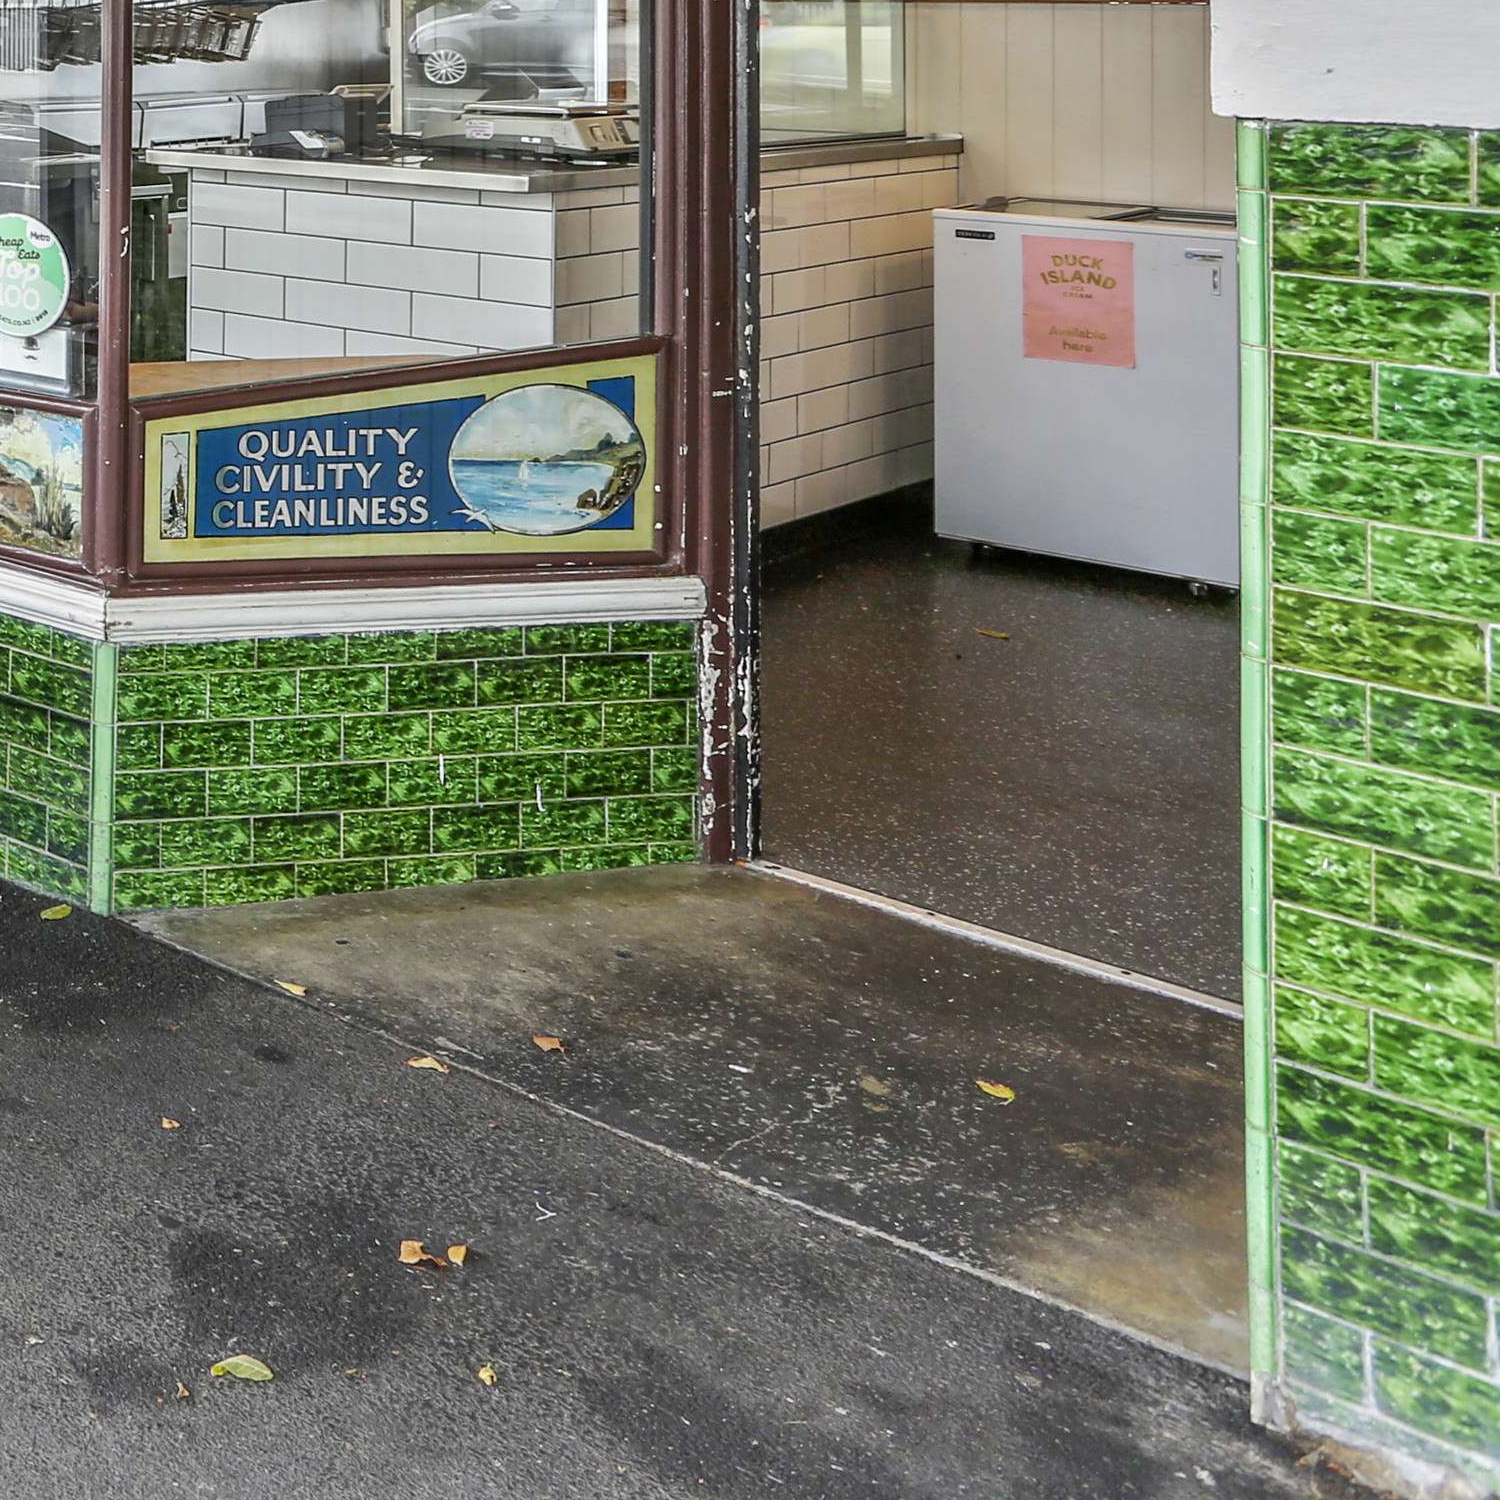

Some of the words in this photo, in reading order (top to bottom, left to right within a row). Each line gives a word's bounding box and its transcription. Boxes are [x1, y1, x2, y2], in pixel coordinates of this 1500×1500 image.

[30, 231, 51, 242] Metro
[17, 249, 41, 260] Eats
[1051, 254, 1104, 270] DUCK
[1040, 269, 1117, 290] ISLAND
[1048, 325, 1107, 341] Available
[1062, 340, 1094, 353] here
[238, 427, 419, 461] QUALITY
[215, 462, 383, 494] CIVILITY
[397, 461, 425, 489] &
[212, 495, 430, 529] CLEANLINESS
